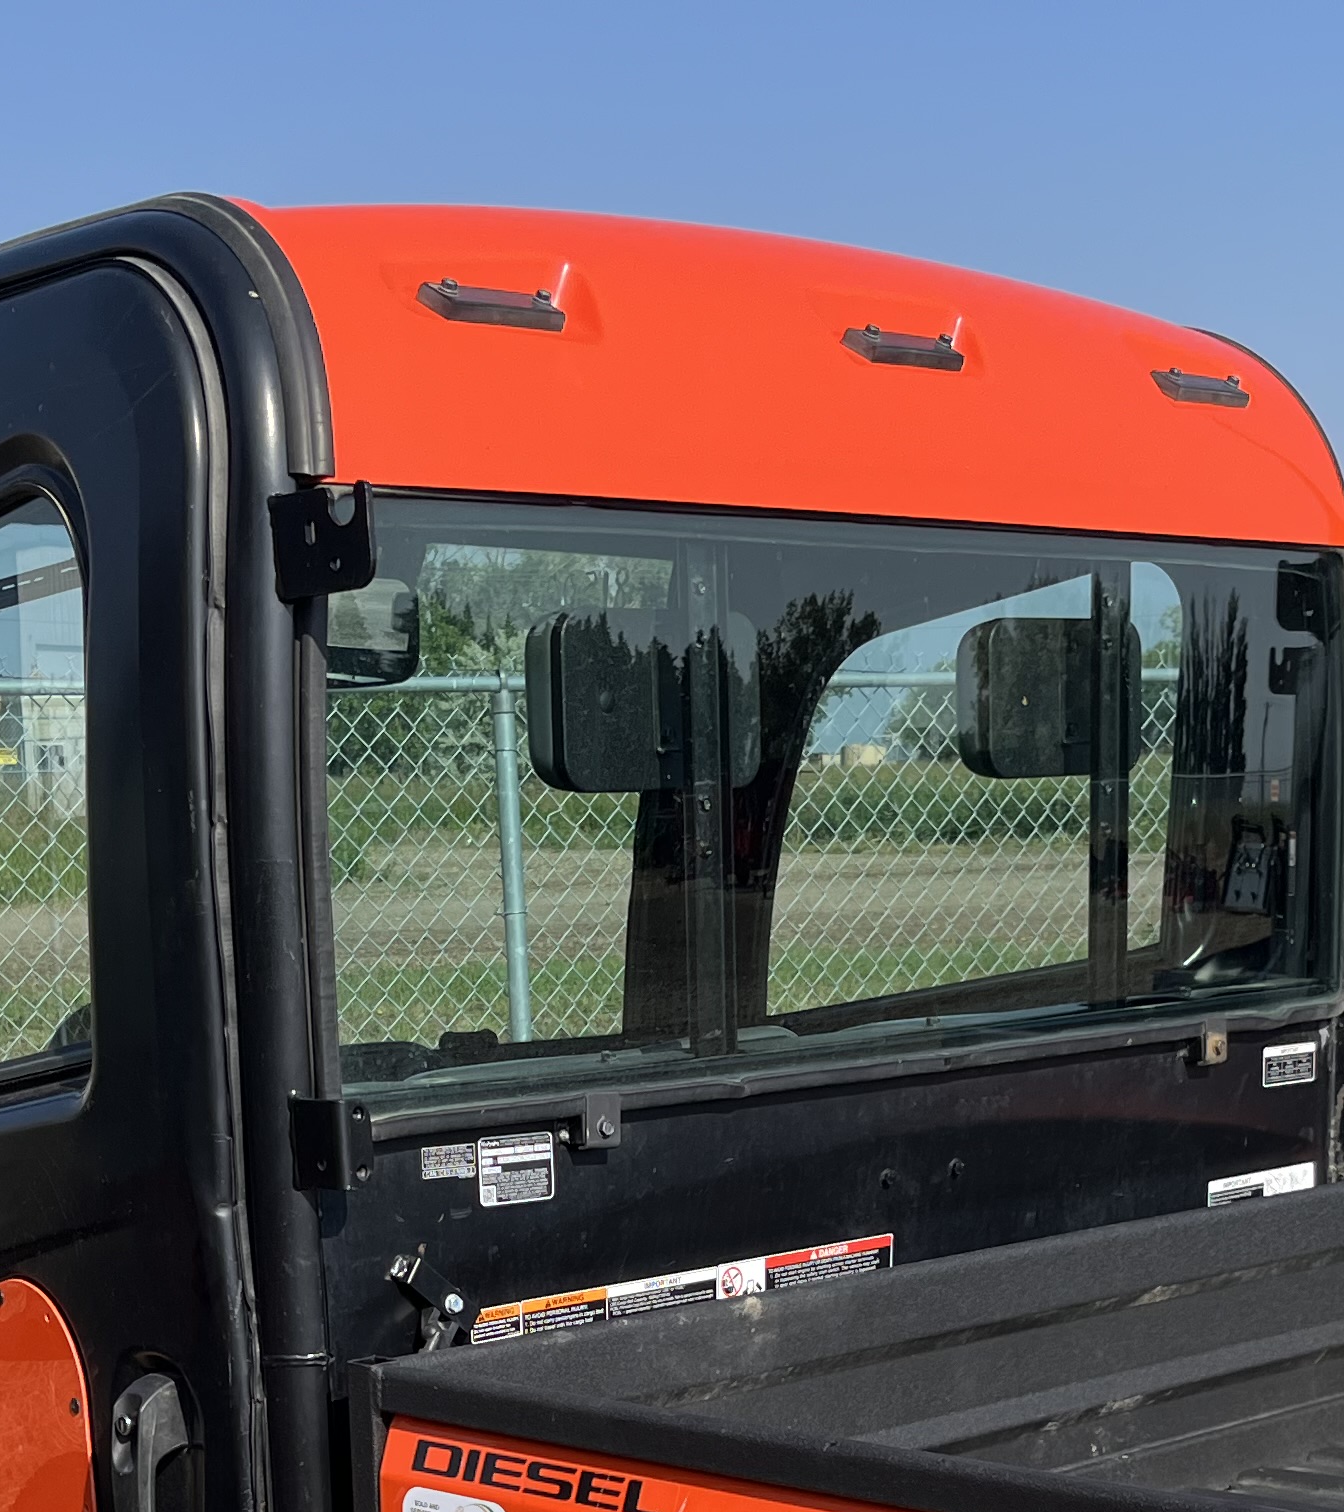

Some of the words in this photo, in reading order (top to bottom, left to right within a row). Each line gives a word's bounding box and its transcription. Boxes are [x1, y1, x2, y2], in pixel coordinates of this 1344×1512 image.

[818, 1244, 849, 1258] DANGER
[643, 1276, 682, 1290] IMPORTANT
[550, 1293, 585, 1306] WARNING
